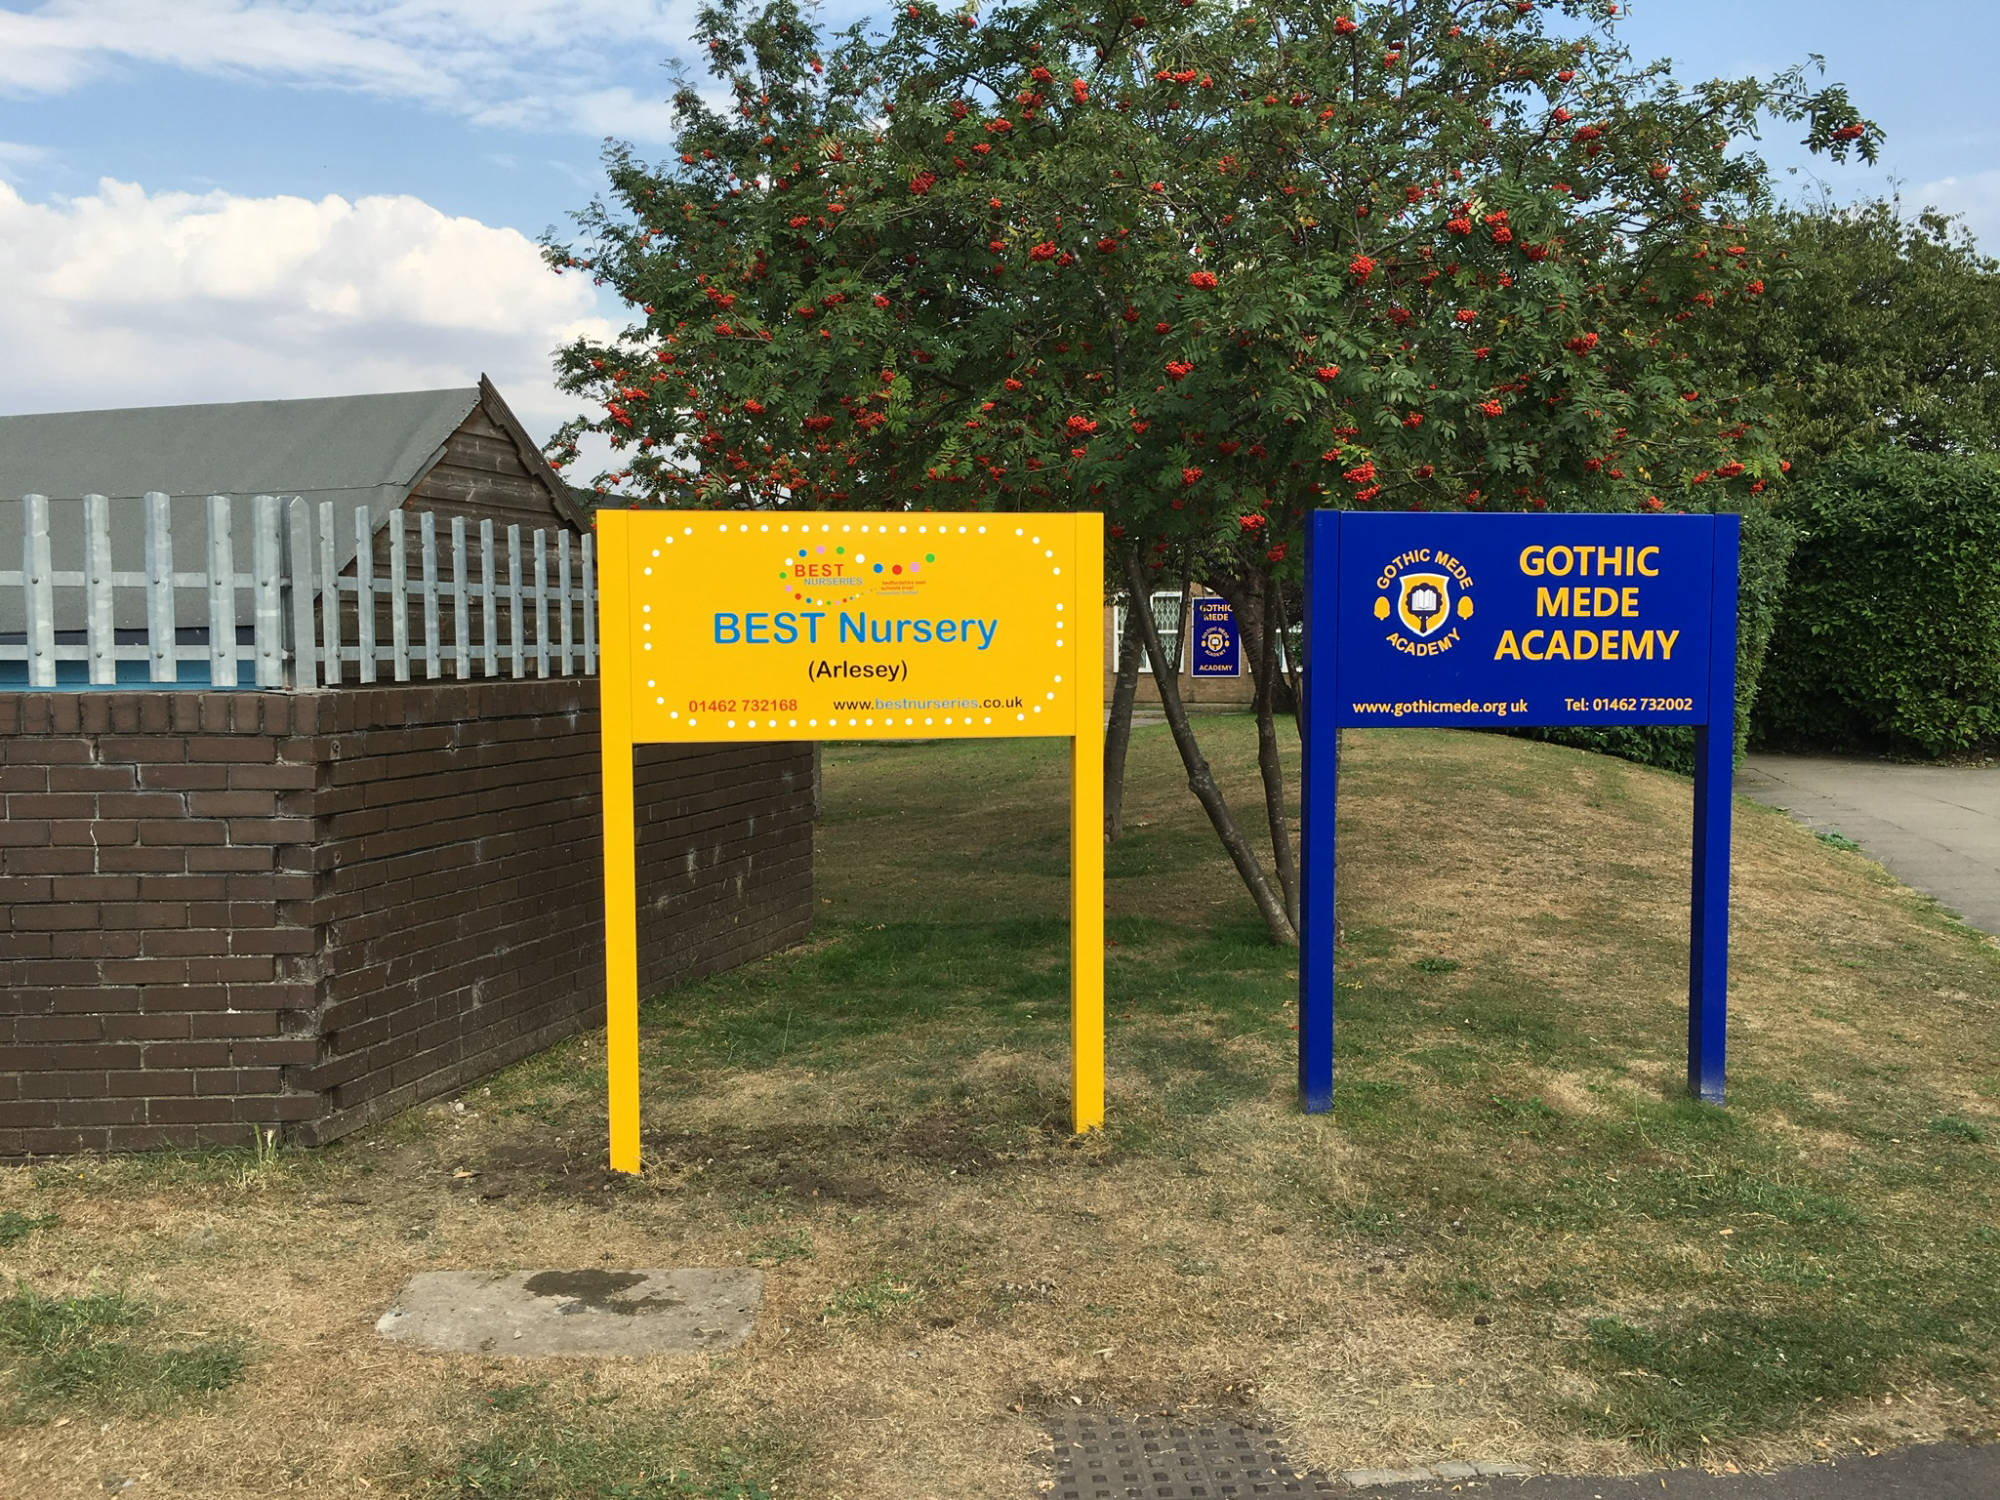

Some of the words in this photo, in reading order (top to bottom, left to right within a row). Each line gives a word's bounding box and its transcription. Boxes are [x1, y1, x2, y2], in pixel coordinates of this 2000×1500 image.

[795, 564, 844, 577] BEST
[1377, 548, 1430, 589] GOTHIC
[1435, 550, 1474, 590] MEDE
[1519, 545, 1659, 576] GOTHIC
[804, 578, 863, 586] NURSERIES
[1536, 587, 1639, 617] MEDE
[714, 611, 826, 644] BEST
[839, 611, 998, 650] Nursery
[1386, 627, 1460, 656] ACADEMY
[1494, 629, 1679, 660] ACADEMY
[808, 659, 907, 682] (Arlesey)
[689, 700, 735, 712] 01462
[742, 699, 797, 712] 732168
[833, 696, 1023, 711] www.bestnurseries.co.uk
[1565, 698, 1589, 712] Tel:
[1592, 698, 1637, 712] 01462
[1640, 698, 1693, 711] 732002
